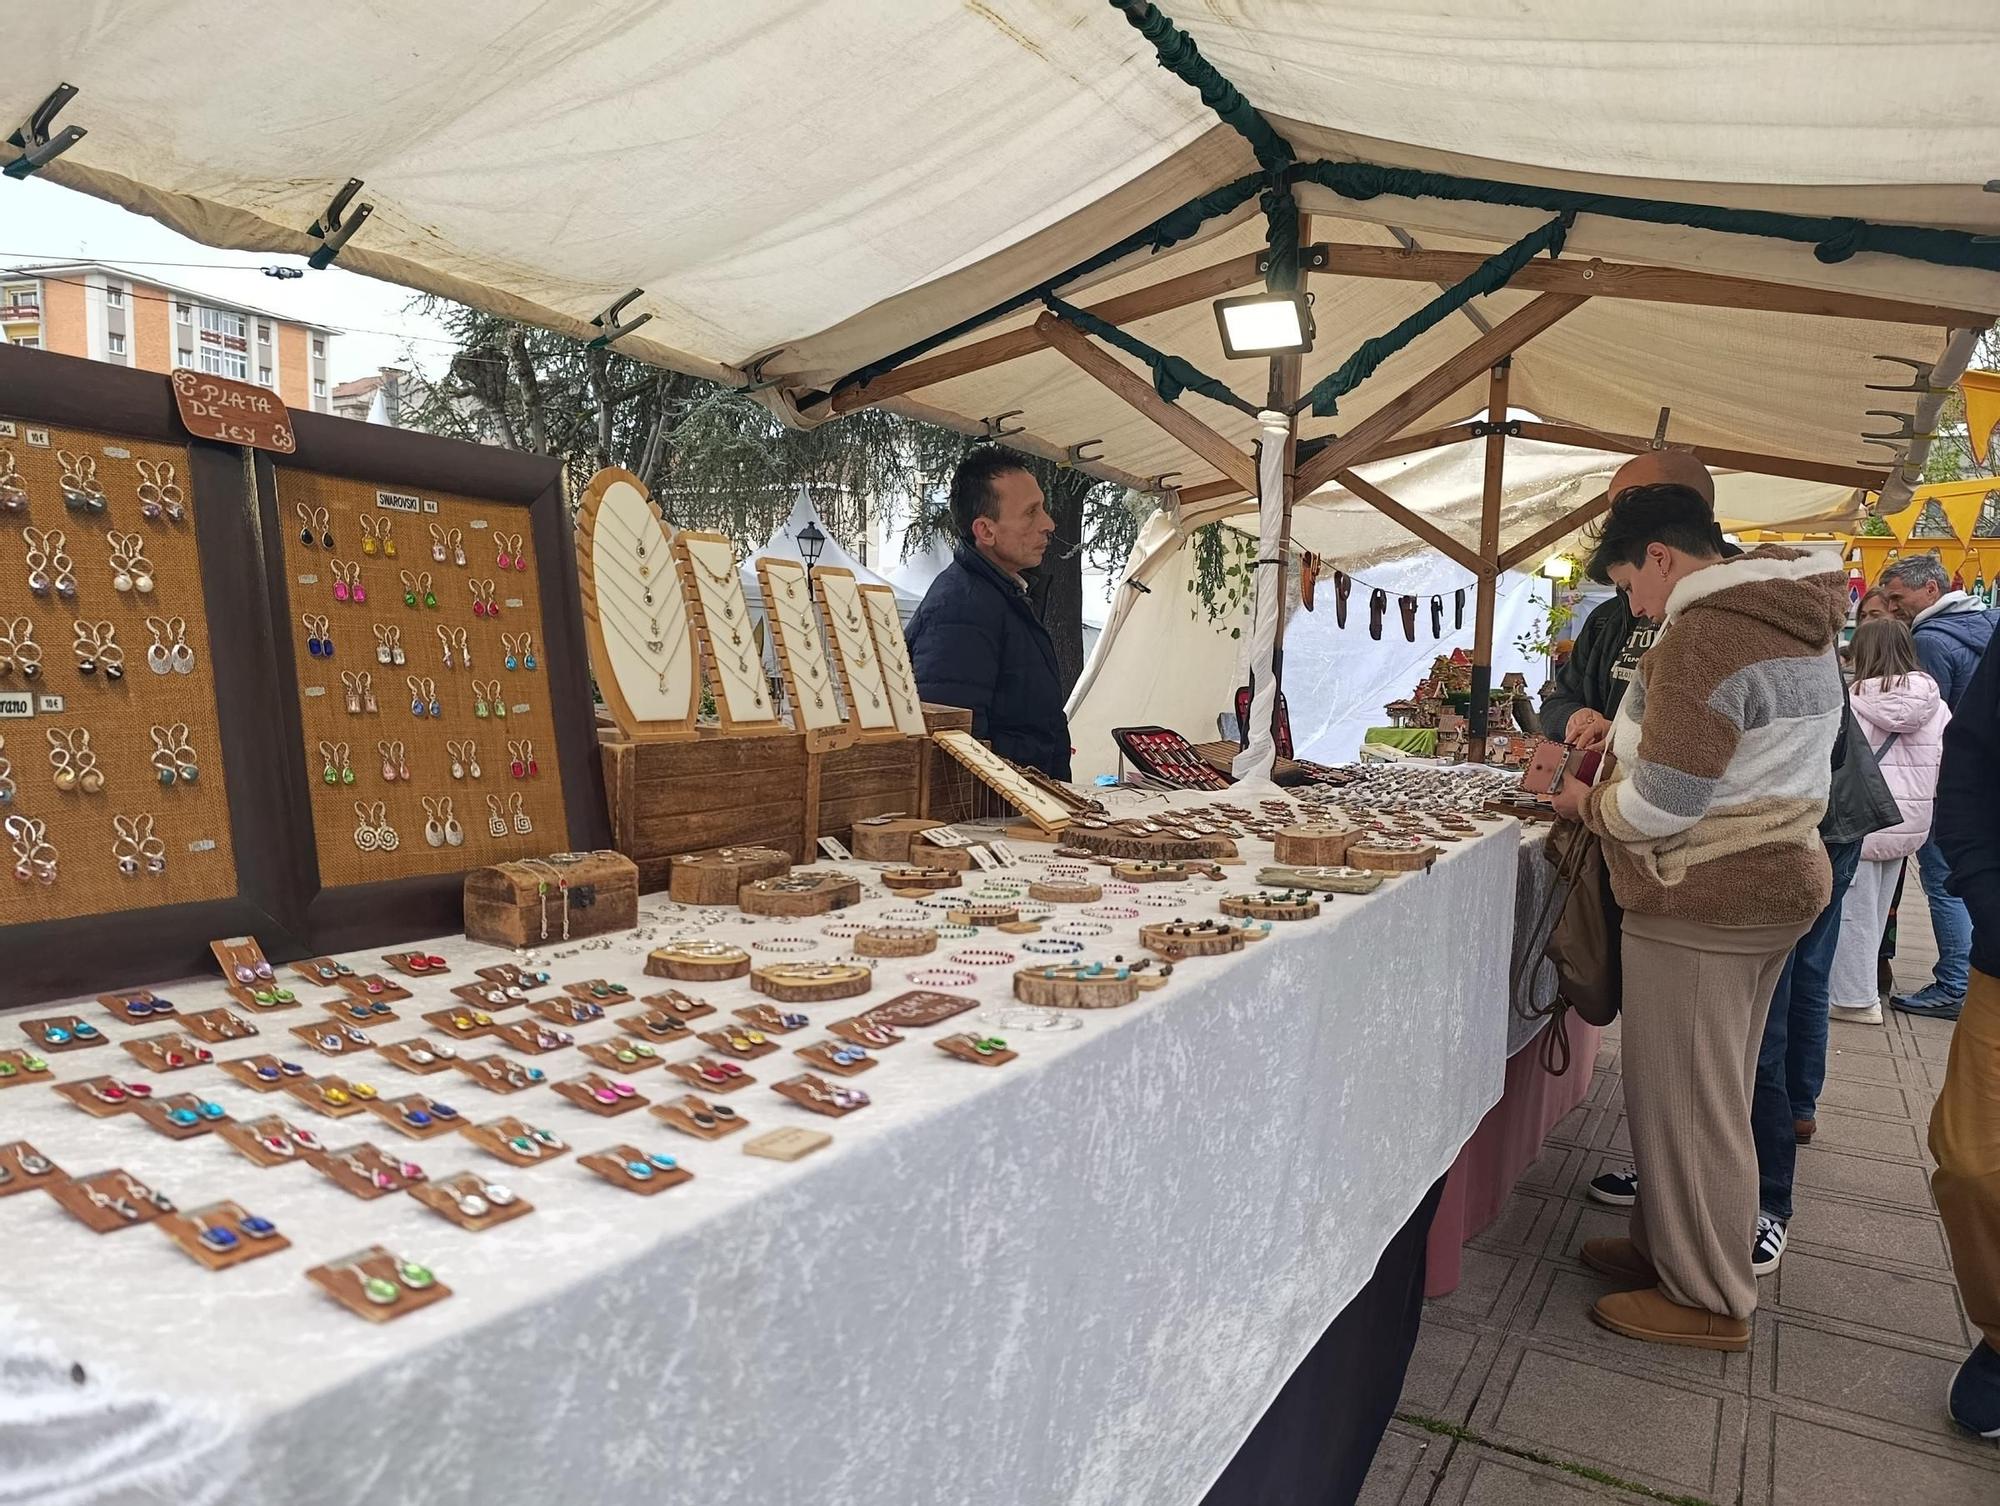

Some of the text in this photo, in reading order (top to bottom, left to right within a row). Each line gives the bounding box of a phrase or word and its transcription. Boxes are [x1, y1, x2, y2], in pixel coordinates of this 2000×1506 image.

[189, 399, 223, 418] DE
[201, 385, 272, 414] PLATA
[379, 494, 418, 511] SWAROVSKI
